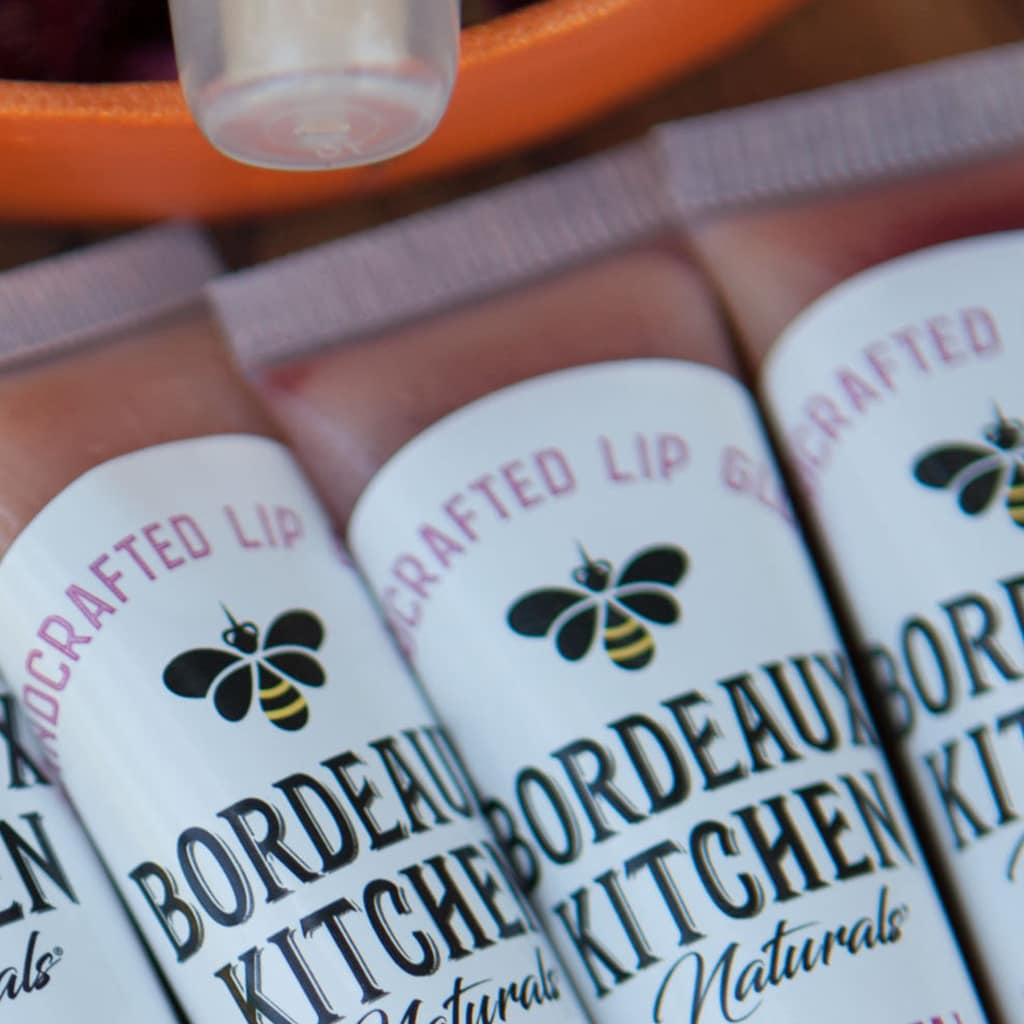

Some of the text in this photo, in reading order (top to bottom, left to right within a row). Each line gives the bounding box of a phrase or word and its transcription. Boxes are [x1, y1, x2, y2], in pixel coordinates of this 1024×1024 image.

[223, 504, 306, 553] LIP
[380, 445, 578, 660] CRAFTED
[596, 431, 692, 485] LIP
[128, 724, 480, 964] BORDEAU
[551, 769, 916, 1000] KITCHEN
